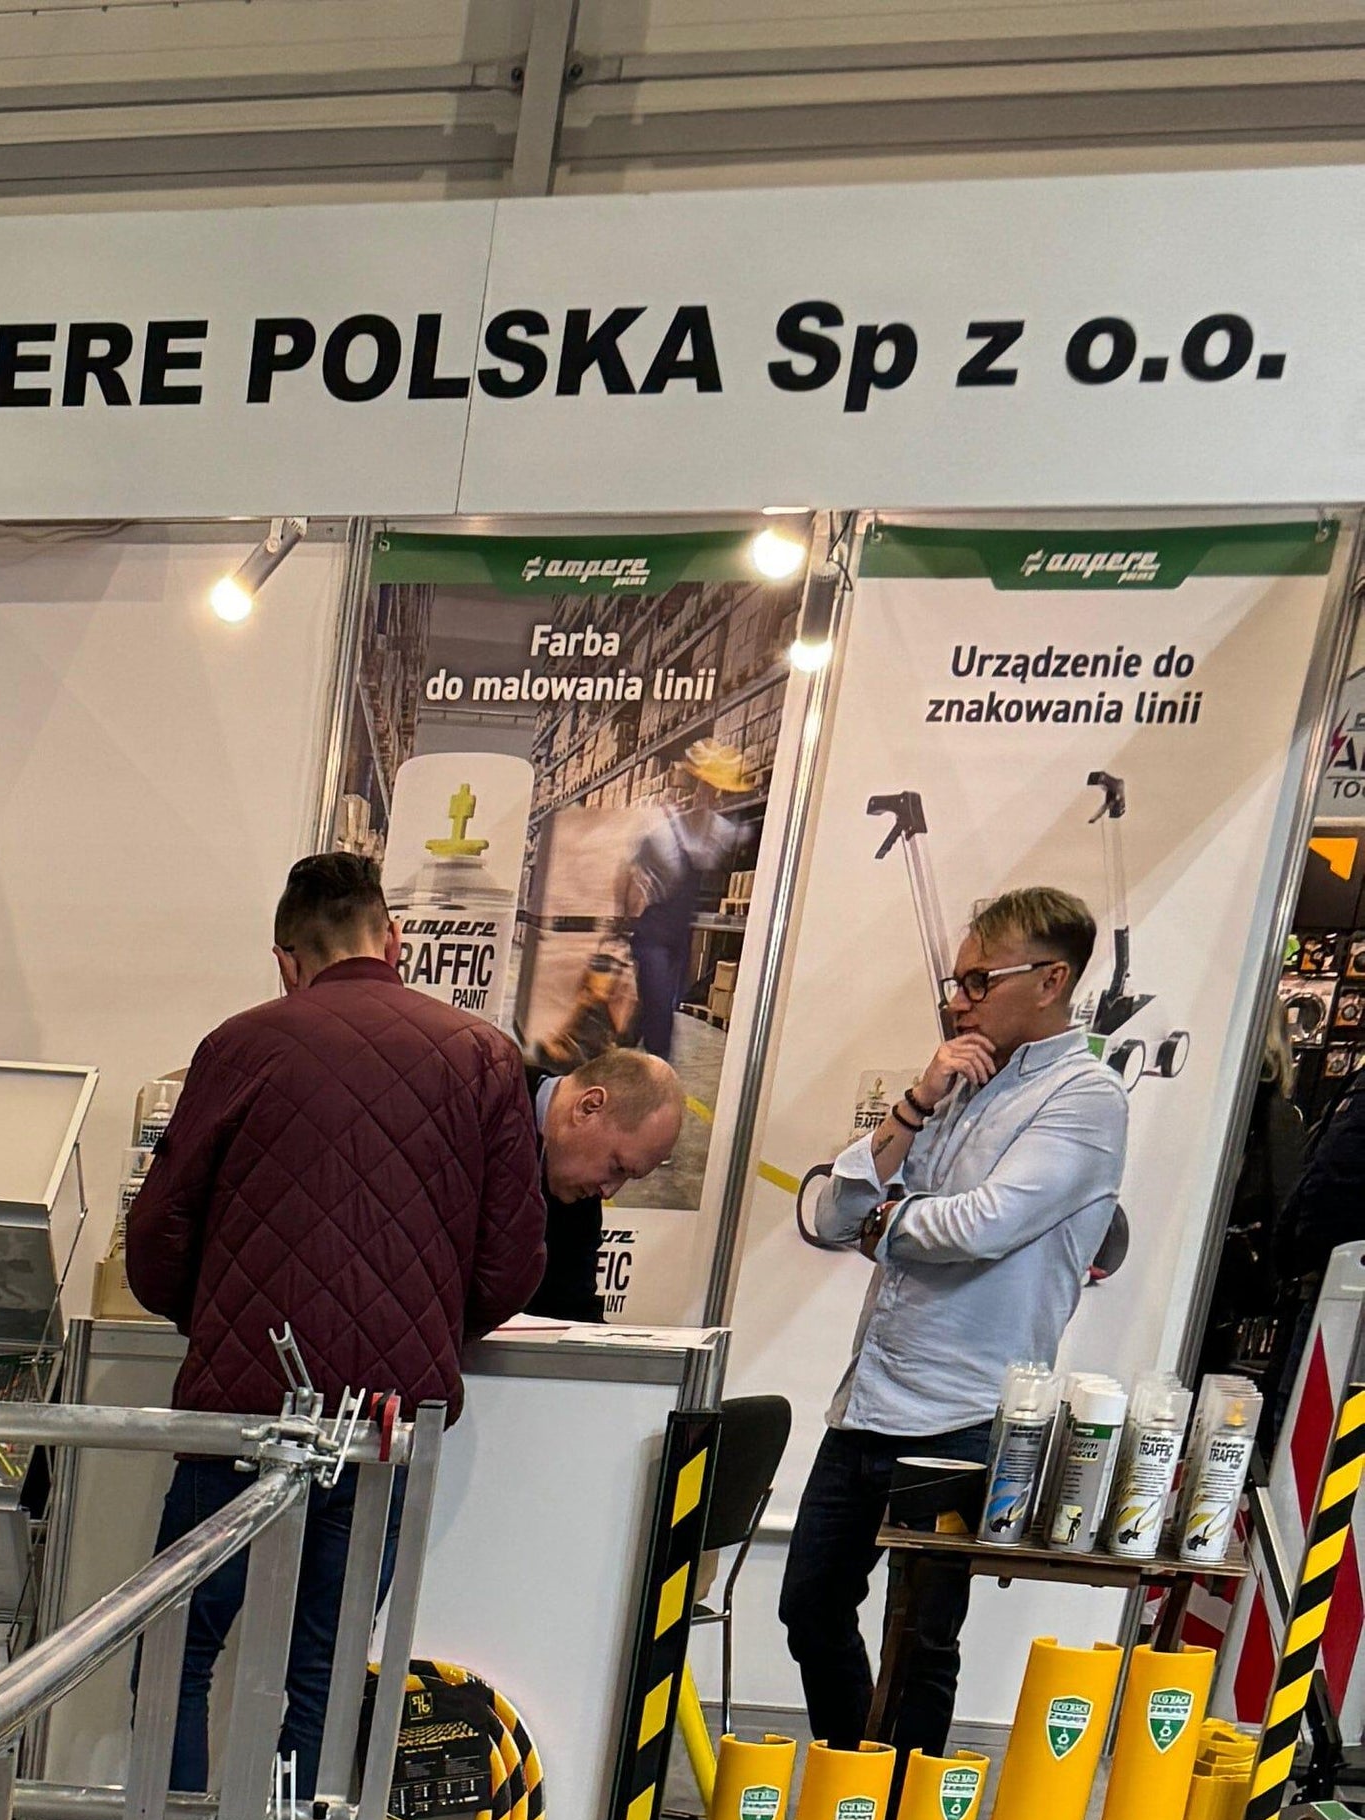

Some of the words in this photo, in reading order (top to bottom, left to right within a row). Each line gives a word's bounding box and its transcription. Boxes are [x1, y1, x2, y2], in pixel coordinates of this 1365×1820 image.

[247, 305, 724, 404] POLSKA
[768, 300, 919, 412] Sp
[956, 320, 1025, 388] z
[1065, 313, 1287, 385] o.o.
[545, 558, 651, 583] ampere
[1045, 551, 1162, 579] ampere
[530, 624, 621, 657] Farba
[950, 645, 1141, 684] Urządzenie
[1153, 645, 1195, 678] do
[425, 669, 463, 701] do
[472, 669, 643, 701] malowania
[652, 669, 716, 701] linii
[925, 691, 1122, 723] znakowania
[1134, 691, 1203, 724] linii
[402, 919, 497, 940] ampere
[396, 942, 494, 987] RAFFIC
[452, 988, 488, 1010] PAINT
[1139, 1442, 1175, 1458] TRAFFIC
[1209, 1448, 1245, 1464] TRAFFIC
